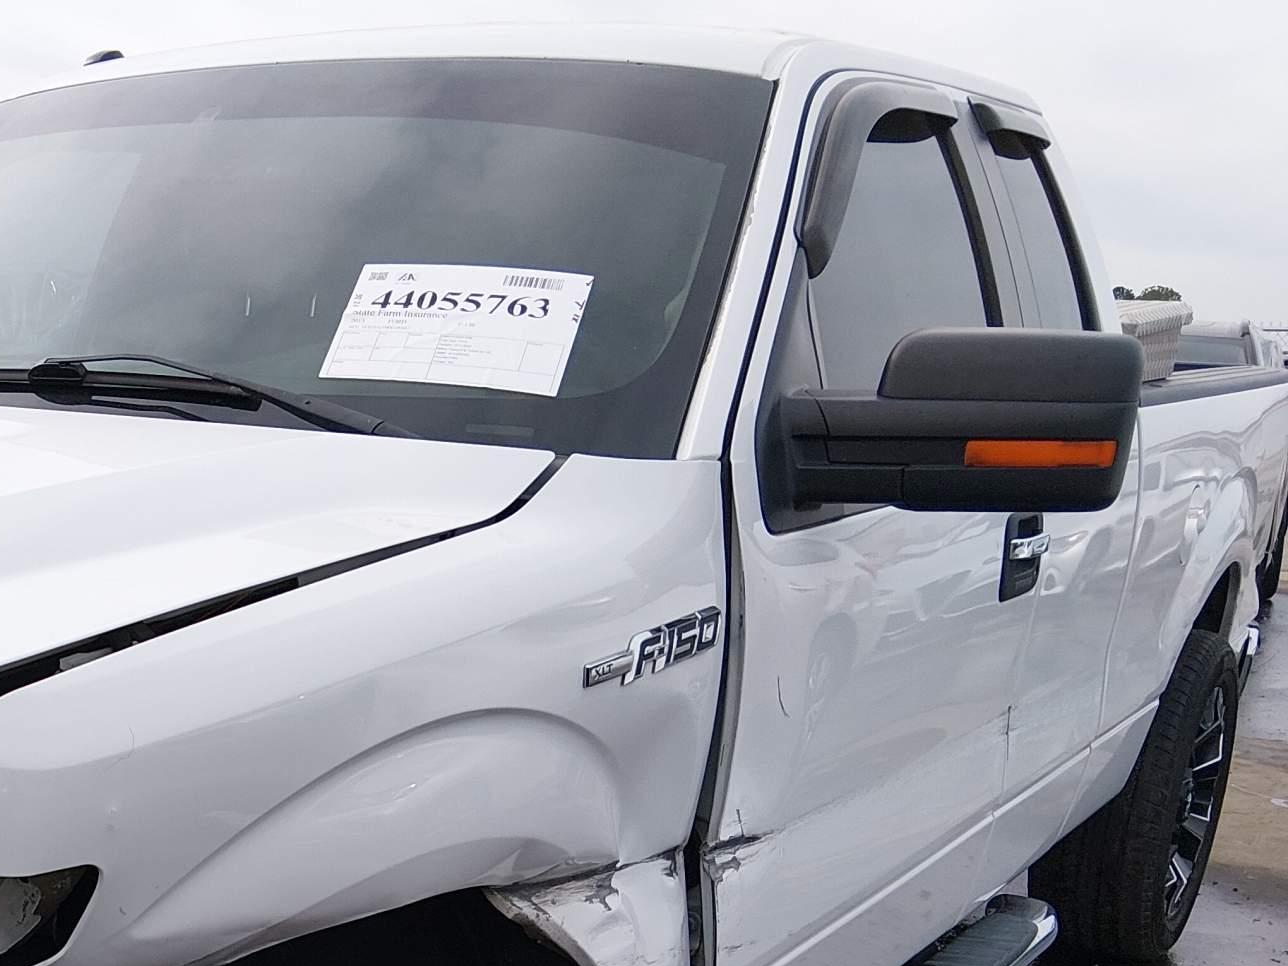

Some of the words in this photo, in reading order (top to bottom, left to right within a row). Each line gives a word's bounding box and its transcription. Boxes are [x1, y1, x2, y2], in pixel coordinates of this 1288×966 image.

[371, 289, 550, 319] 44055763
[377, 310, 402, 318] Farm
[404, 310, 449, 319] Insurance
[593, 663, 614, 680] XLT
